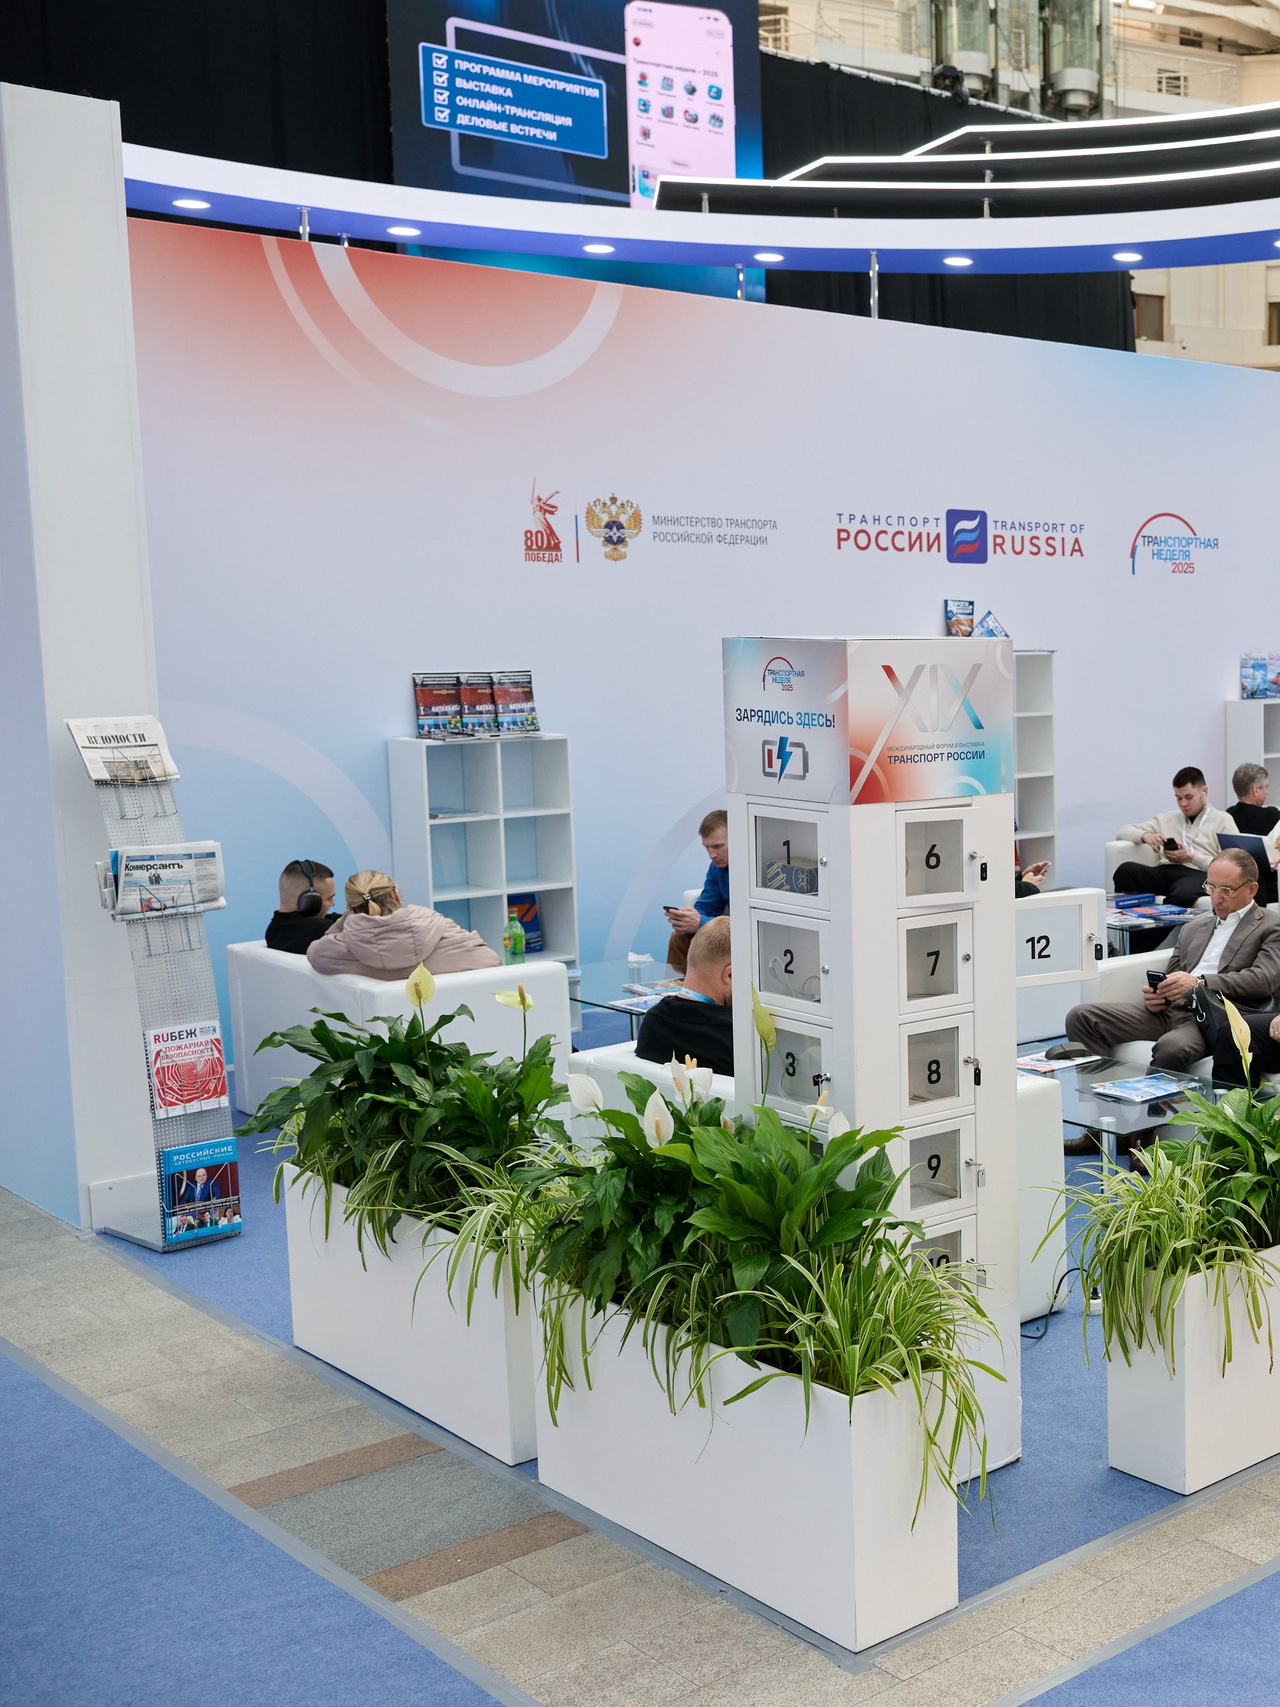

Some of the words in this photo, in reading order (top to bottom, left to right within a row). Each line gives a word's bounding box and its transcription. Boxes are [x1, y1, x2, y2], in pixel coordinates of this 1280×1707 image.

[455, 59, 522, 82] ПРОГРАММА
[523, 74, 600, 98] МЕРОПРИЯТИЯ
[455, 77, 513, 98] ВЫСТАВКА
[455, 96, 573, 127] ОНЛАЙН-ТРАНСЛЯЦИЯ
[456, 114, 509, 132] ДЕЛОВЫЕ
[510, 123, 557, 141] ВСТРЕЧИ
[652, 515, 723, 528] МИНИСТЕРСТВО
[725, 518, 778, 530] ТРАНСПОРТА
[836, 513, 941, 527] ТРАНСПОРТ
[993, 520, 1066, 533] TRANSPORT
[1070, 523, 1085, 534] OF
[524, 530, 545, 549] 80
[653, 531, 714, 543] РОССИЙСКОЙ
[716, 534, 768, 547] ФЕДЕРАЦИИ
[837, 528, 941, 553] РОССИИ
[993, 534, 1084, 557] RUSSIA
[1141, 535, 1219, 549] ТРАНСПОРТНАЯ
[524, 552, 563, 563] ПОБЕДА!
[1152, 549, 1191, 562] НЕДЕЛЯ
[1171, 562, 1195, 574] 2025
[767, 669, 805, 678] ТРАНСПОРТНАЯ
[735, 707, 794, 726] ЗАРЯДИСЬ
[796, 711, 836, 729] ЗДЕСЬ!
[86, 733, 147, 745] ВЕДОМОСТИ
[887, 743, 936, 752] МЕЖДУНАРОДНЫЙ
[936, 742, 954, 750] ФОРУМ
[888, 752, 944, 765] ТРАНСПОРТ
[947, 750, 985, 761] РОССИИ
[782, 840, 791, 864] 1
[925, 844, 941, 870] 6
[124, 862, 184, 872] Коммерсантъ
[1026, 935, 1051, 960] 12
[783, 949, 794, 975] 2
[926, 950, 941, 977] 7
[161, 1047, 214, 1061] БЕЗОПАСНОСТЬ
[164, 1040, 209, 1053] ПОЖАРНАЯ
[785, 1052, 796, 1077] 3
[927, 1059, 942, 1085] 8
[173, 1145, 233, 1161] РОССИЙСКИЕ
[174, 1156, 211, 1166] АВТОБУСНЫЕ
[213, 1151, 233, 1159] ЛИНИИ
[927, 1154, 942, 1180] 9
